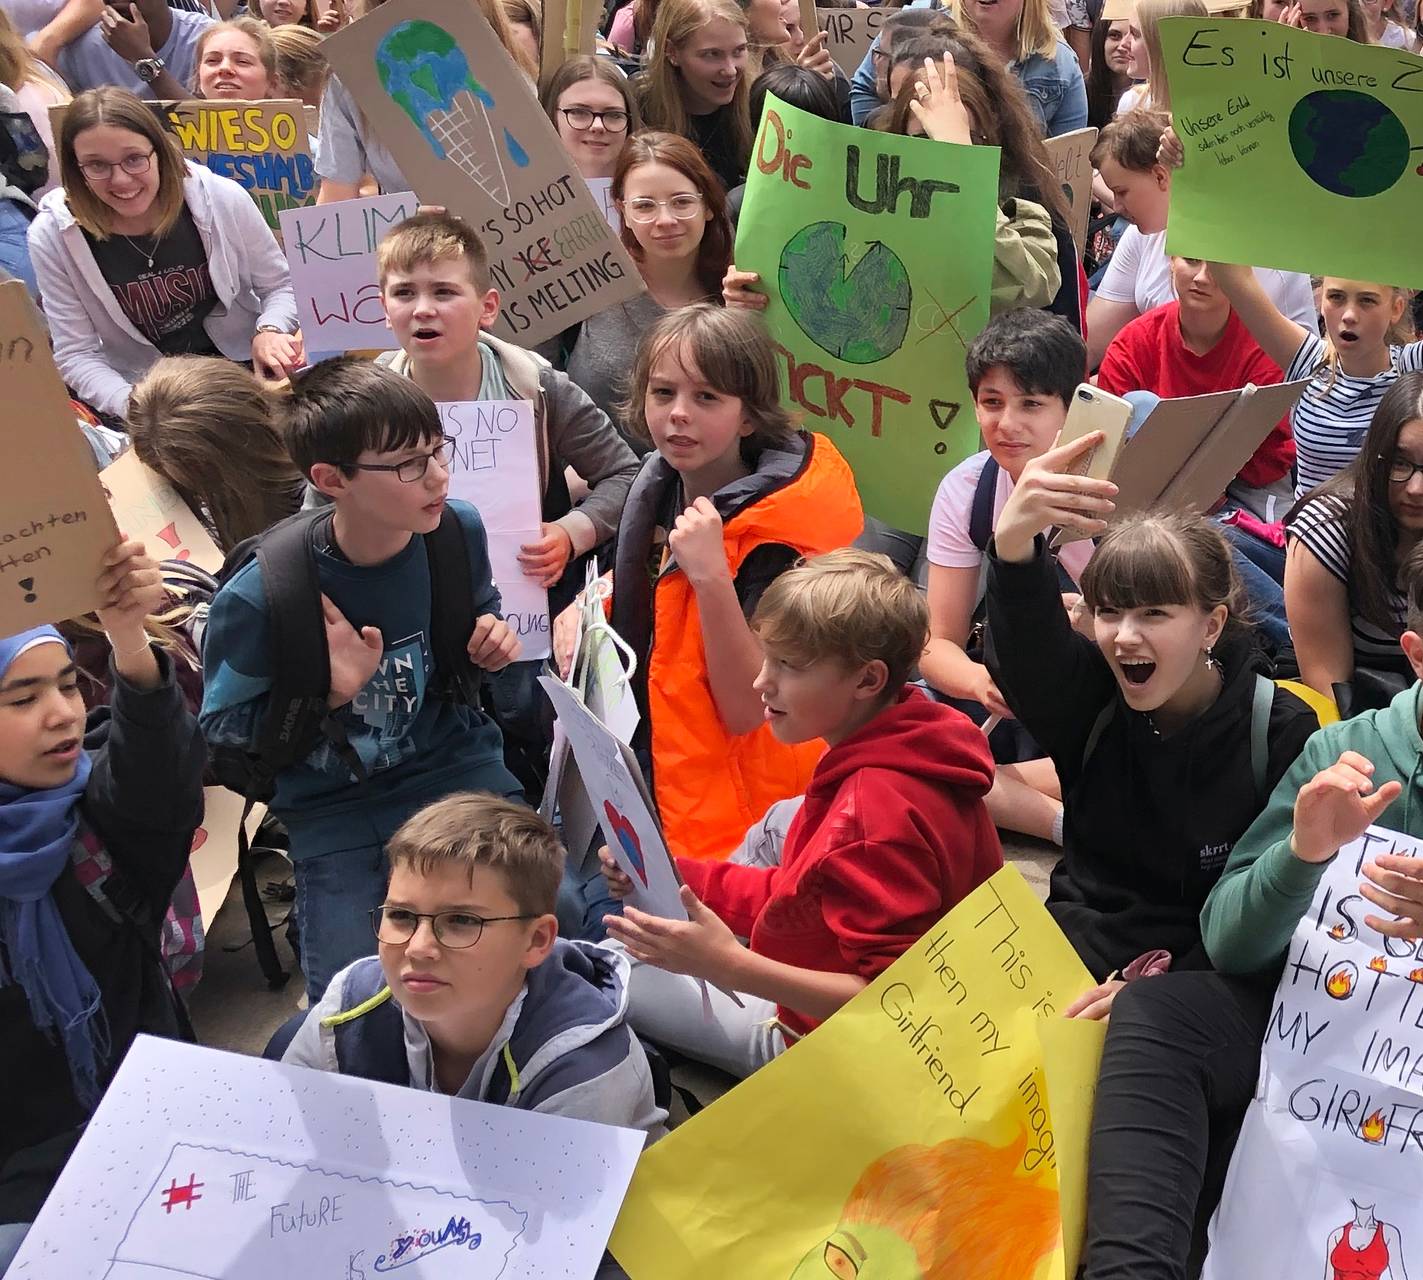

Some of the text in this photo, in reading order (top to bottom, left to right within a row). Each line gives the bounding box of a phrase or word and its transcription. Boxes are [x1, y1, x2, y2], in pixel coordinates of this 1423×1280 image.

[1183, 29, 1234, 67] Es
[1261, 31, 1294, 80] ist
[1312, 66, 1378, 87] unsere
[168, 108, 297, 152] WIESO
[1181, 112, 1224, 137] Unsere
[757, 108, 961, 219] Die Uhr
[503, 206, 535, 235] SO
[534, 174, 577, 218] HOT
[553, 209, 609, 260] EARTH
[501, 250, 626, 333] IS MELTING
[475, 404, 519, 438] NO
[451, 438, 503, 475] NET
[0, 509, 88, 546] achten
[352, 693, 418, 714] CITY
[1315, 884, 1364, 945] IS
[974, 880, 1056, 1020] This is
[924, 929, 968, 1006] then
[970, 1011, 1011, 1057] my
[880, 982, 983, 1125] Girlfriend.
[1263, 1000, 1331, 1056] MY
[229, 1169, 257, 1204] THE
